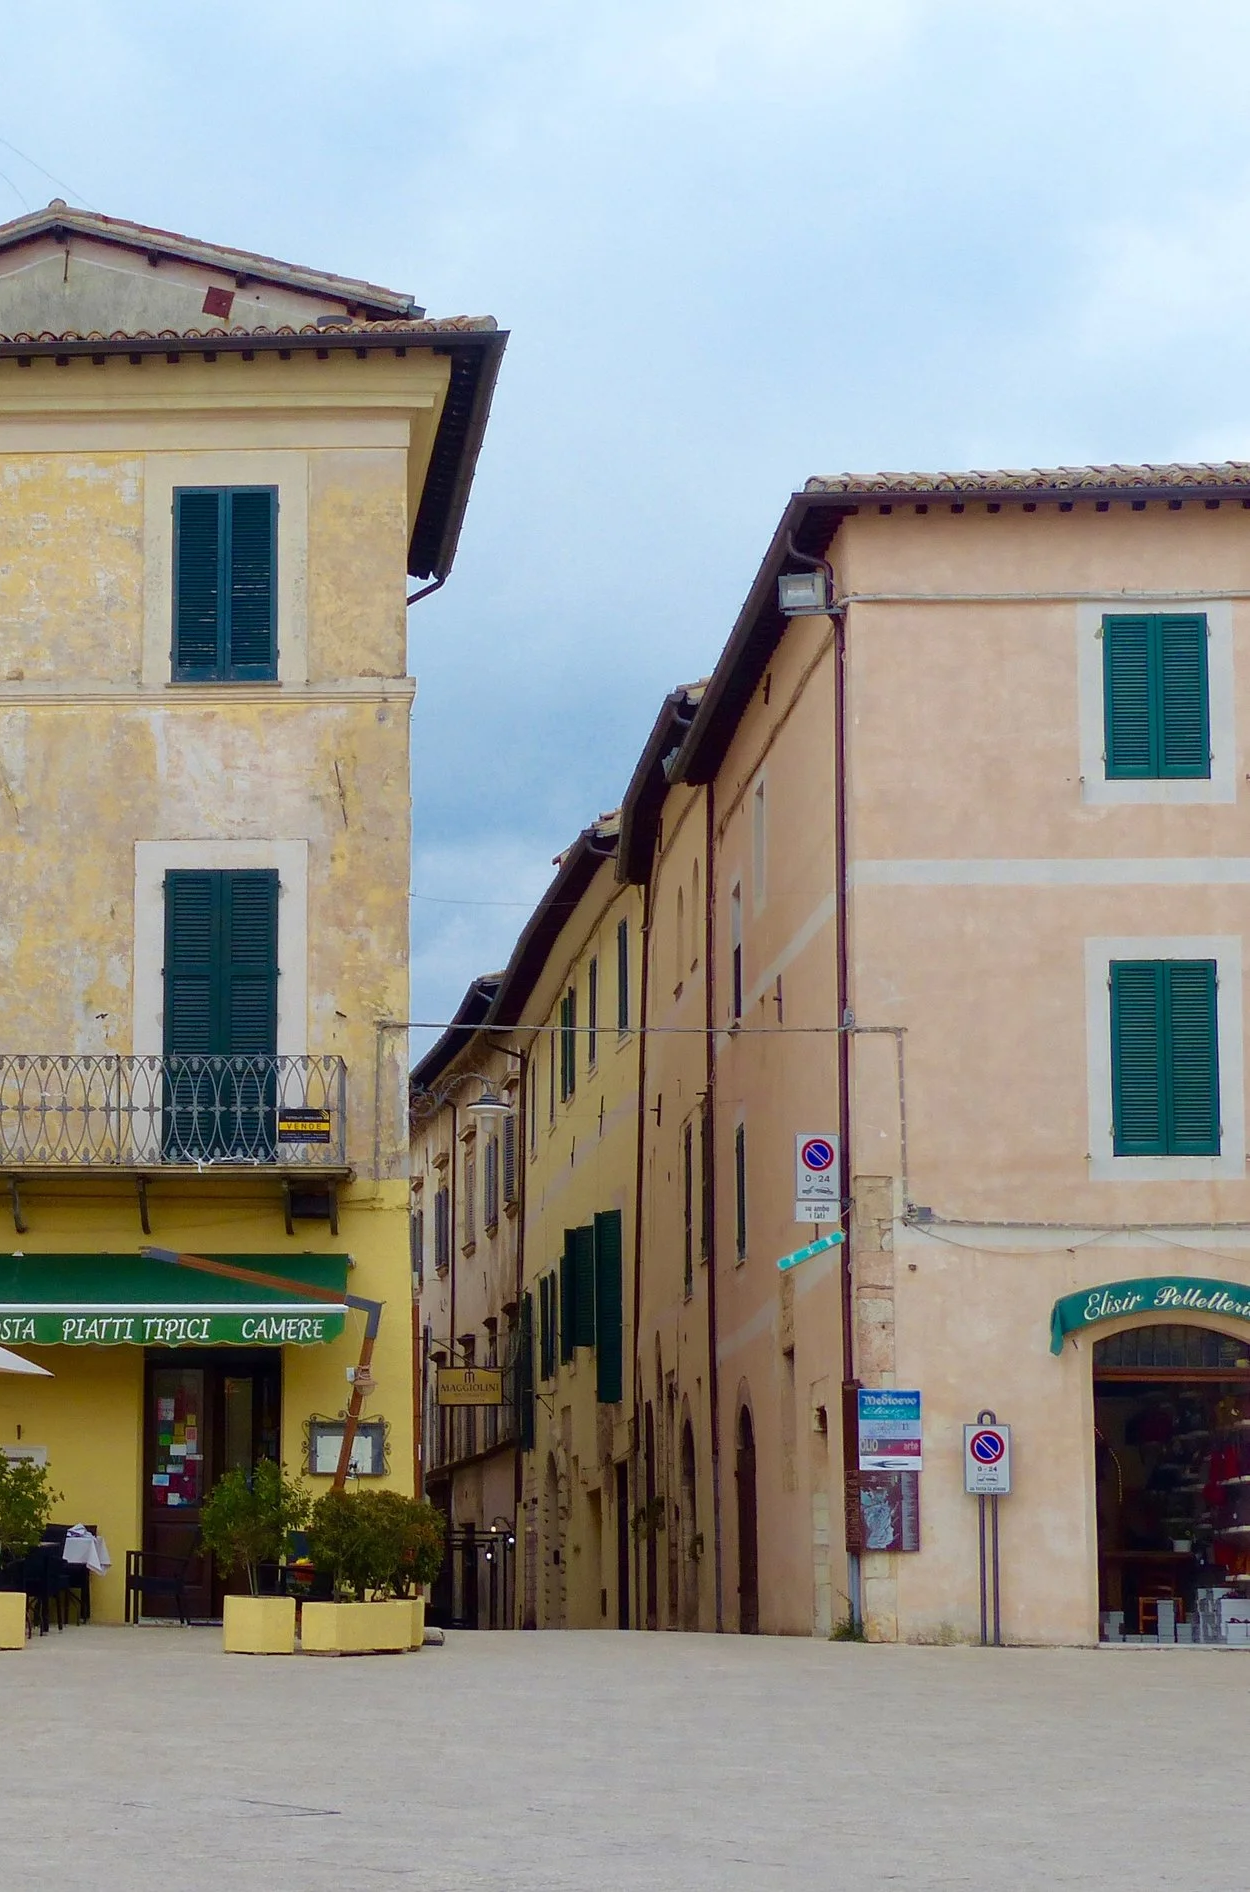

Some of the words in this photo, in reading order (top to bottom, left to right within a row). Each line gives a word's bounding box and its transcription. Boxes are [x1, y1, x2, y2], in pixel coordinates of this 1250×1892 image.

[818, 1174, 831, 1183] 24
[1083, 1290, 1144, 1321] Elisir
[62, 1318, 135, 1341] PIATTI
[142, 1318, 211, 1341] TIPICI
[241, 1317, 325, 1341] CAMERE
[440, 1383, 500, 1393] MAGGIOLINI
[861, 1393, 918, 1406] Medioevo
[860, 1439, 879, 1452] OLIO
[903, 1441, 919, 1451] arte
